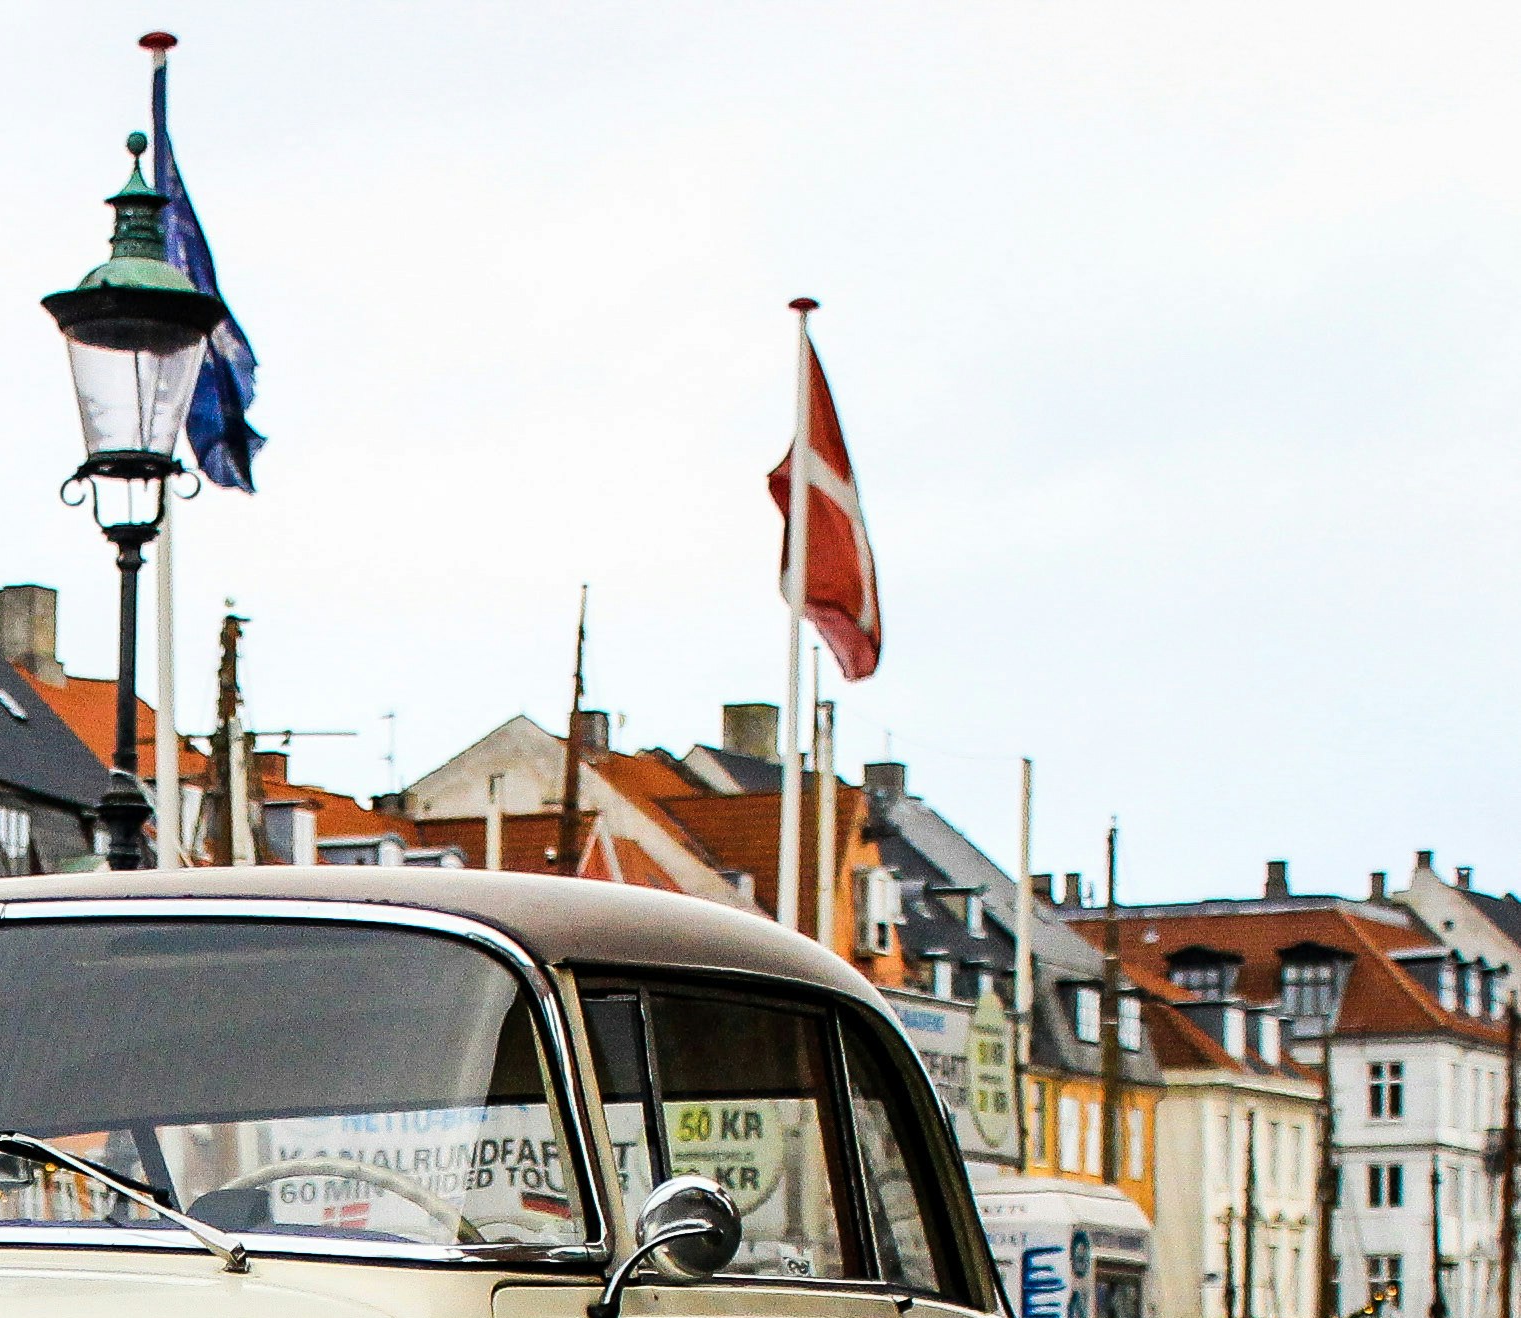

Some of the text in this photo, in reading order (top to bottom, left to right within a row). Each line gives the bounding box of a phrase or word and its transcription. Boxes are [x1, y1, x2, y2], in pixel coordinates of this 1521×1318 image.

[676, 1108, 762, 1141] 50 KR
[715, 1166, 760, 1190] KR
[281, 1182, 316, 1203] 60
